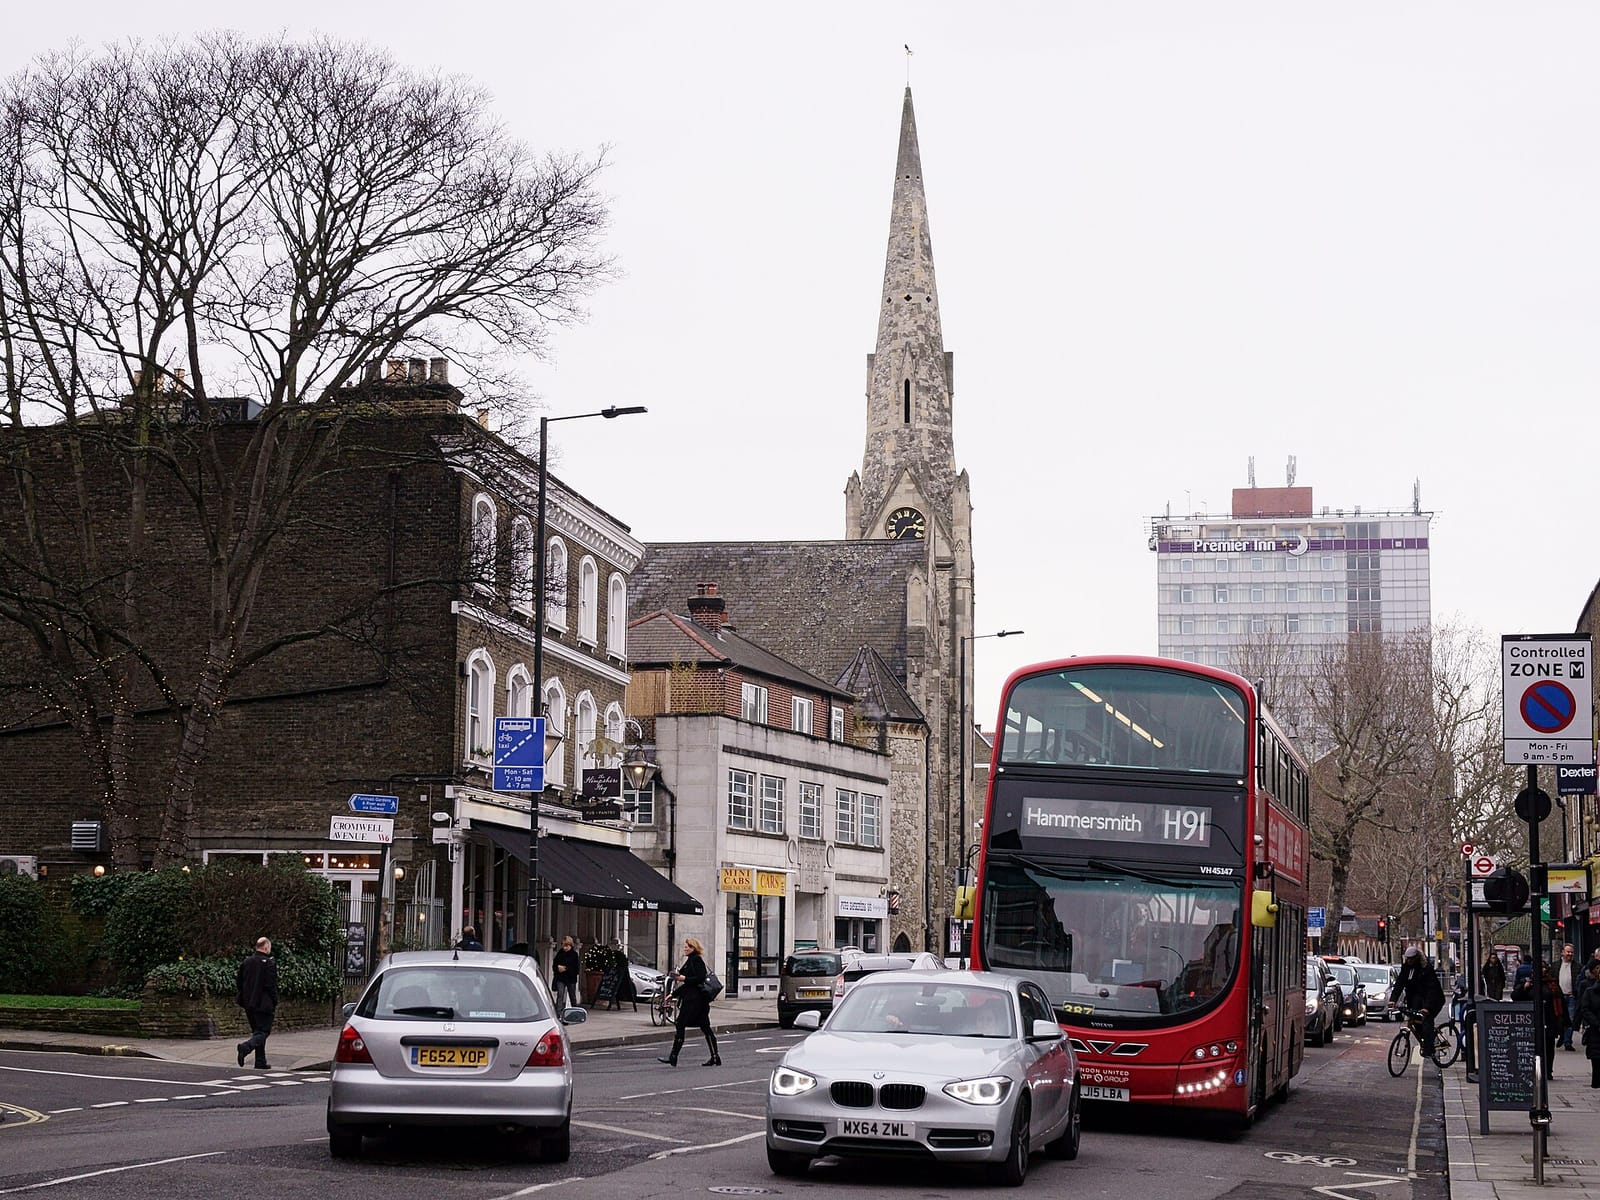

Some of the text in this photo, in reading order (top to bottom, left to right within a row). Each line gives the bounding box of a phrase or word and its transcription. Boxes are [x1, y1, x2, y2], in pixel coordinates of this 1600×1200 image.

[1193, 539, 1276, 552] Premier Inn
[1510, 647, 1585, 657] Controlled
[1510, 663, 1584, 677] ZONE M
[1560, 754, 1574, 762] pm
[1560, 767, 1597, 778] Dexter
[333, 821, 384, 832] CROMWELL
[1027, 807, 1206, 841] Hammersmith H91
[334, 831, 368, 841] AVENUE
[724, 868, 750, 877] MINI
[723, 877, 750, 885] CABS
[760, 874, 779, 889] CARS
[420, 1049, 486, 1063] FG52 YOP
[1103, 1075, 1130, 1083] GROUP
[1102, 1087, 1123, 1099] LBA
[843, 1120, 909, 1137] MX64 ZWL
